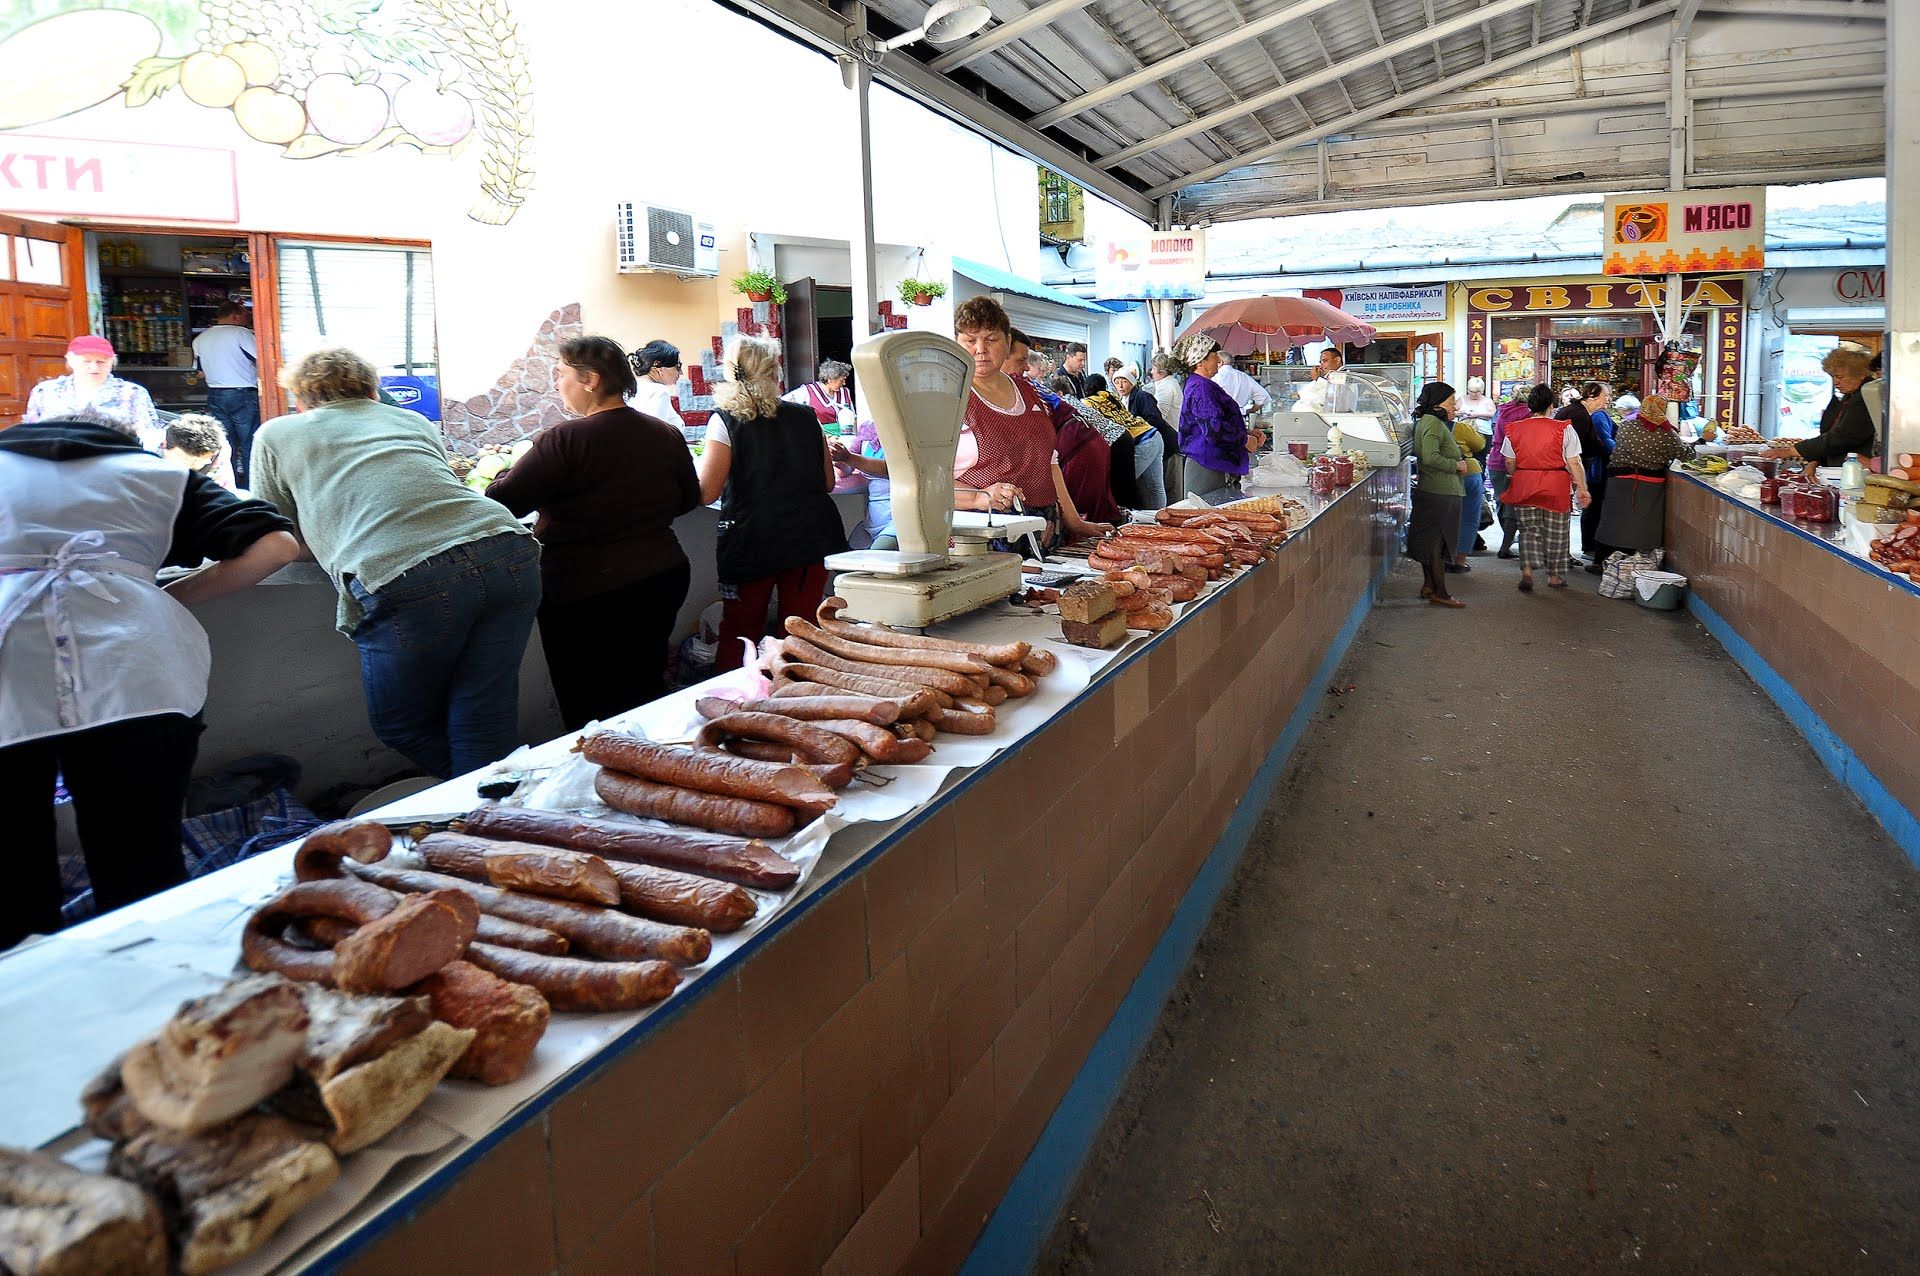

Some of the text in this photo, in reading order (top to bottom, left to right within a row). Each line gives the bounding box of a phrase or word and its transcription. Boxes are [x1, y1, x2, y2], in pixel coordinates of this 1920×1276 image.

[1151, 238, 1193, 253] МОЛОКО
[1344, 289, 1443, 302] КИЇВСЬКІ НАПІВФАБРИКАТИ
[1469, 281, 1739, 312] СВІТА
[1365, 301, 1422, 312] ВІД ВИРОБНИКА
[1721, 312, 1738, 400] КОВБАСИ
